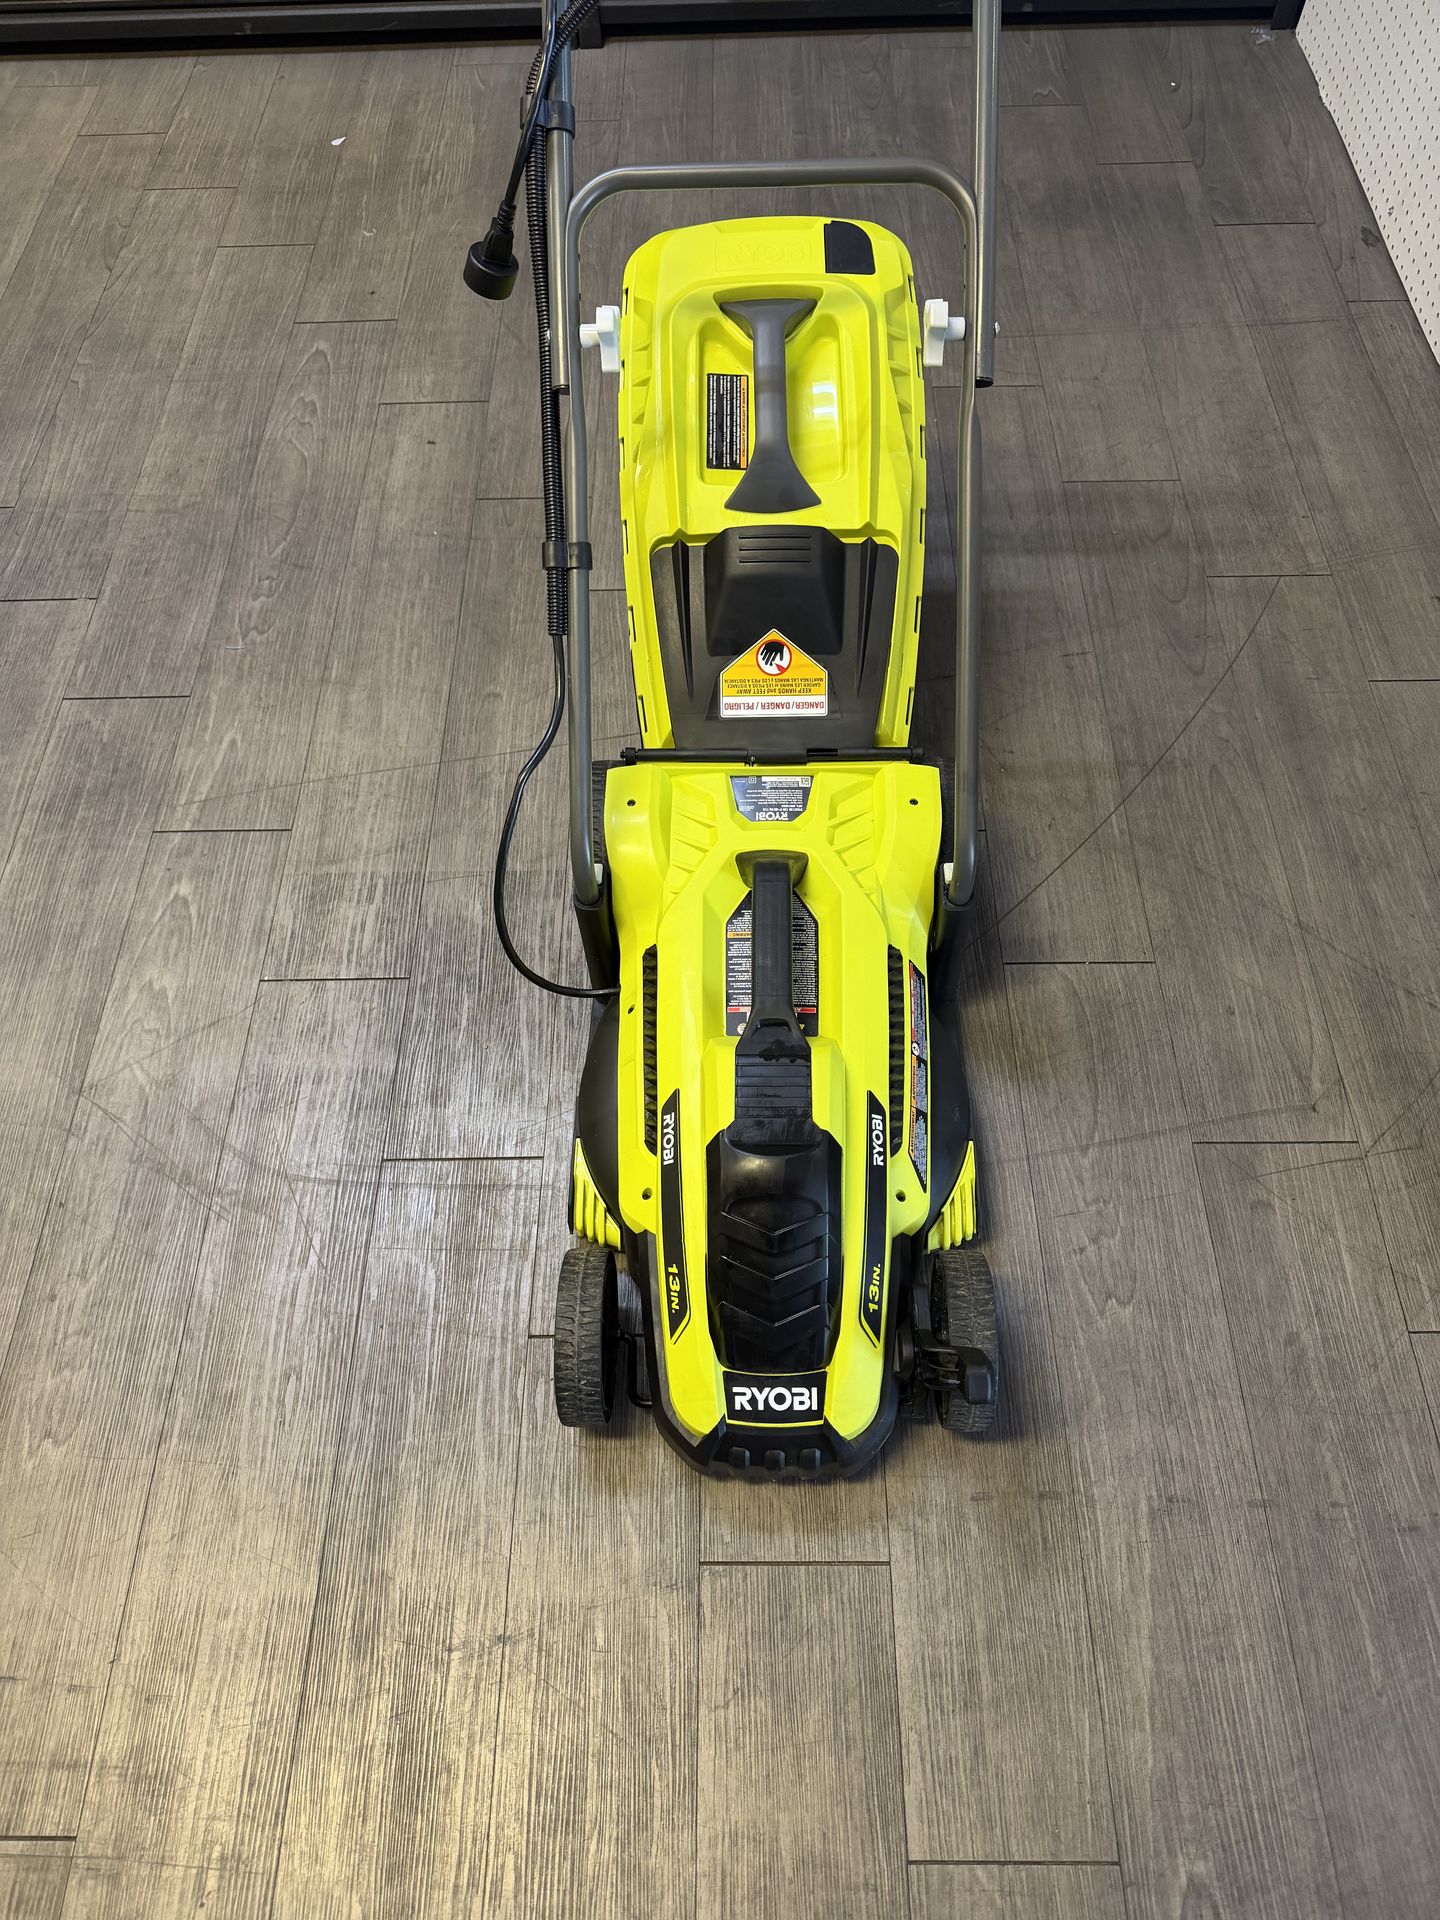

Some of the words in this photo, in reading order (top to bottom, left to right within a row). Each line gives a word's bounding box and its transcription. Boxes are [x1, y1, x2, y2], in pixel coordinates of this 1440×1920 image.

[724, 702, 754, 710] PELIGRO
[761, 701, 790, 710] DANGER
[795, 701, 824, 709] DANGER
[756, 812, 788, 820] RYOBI
[663, 1112, 674, 1165] RYOBI
[872, 1114, 884, 1166] RYOBI
[732, 1386, 818, 1411] RYOBI
